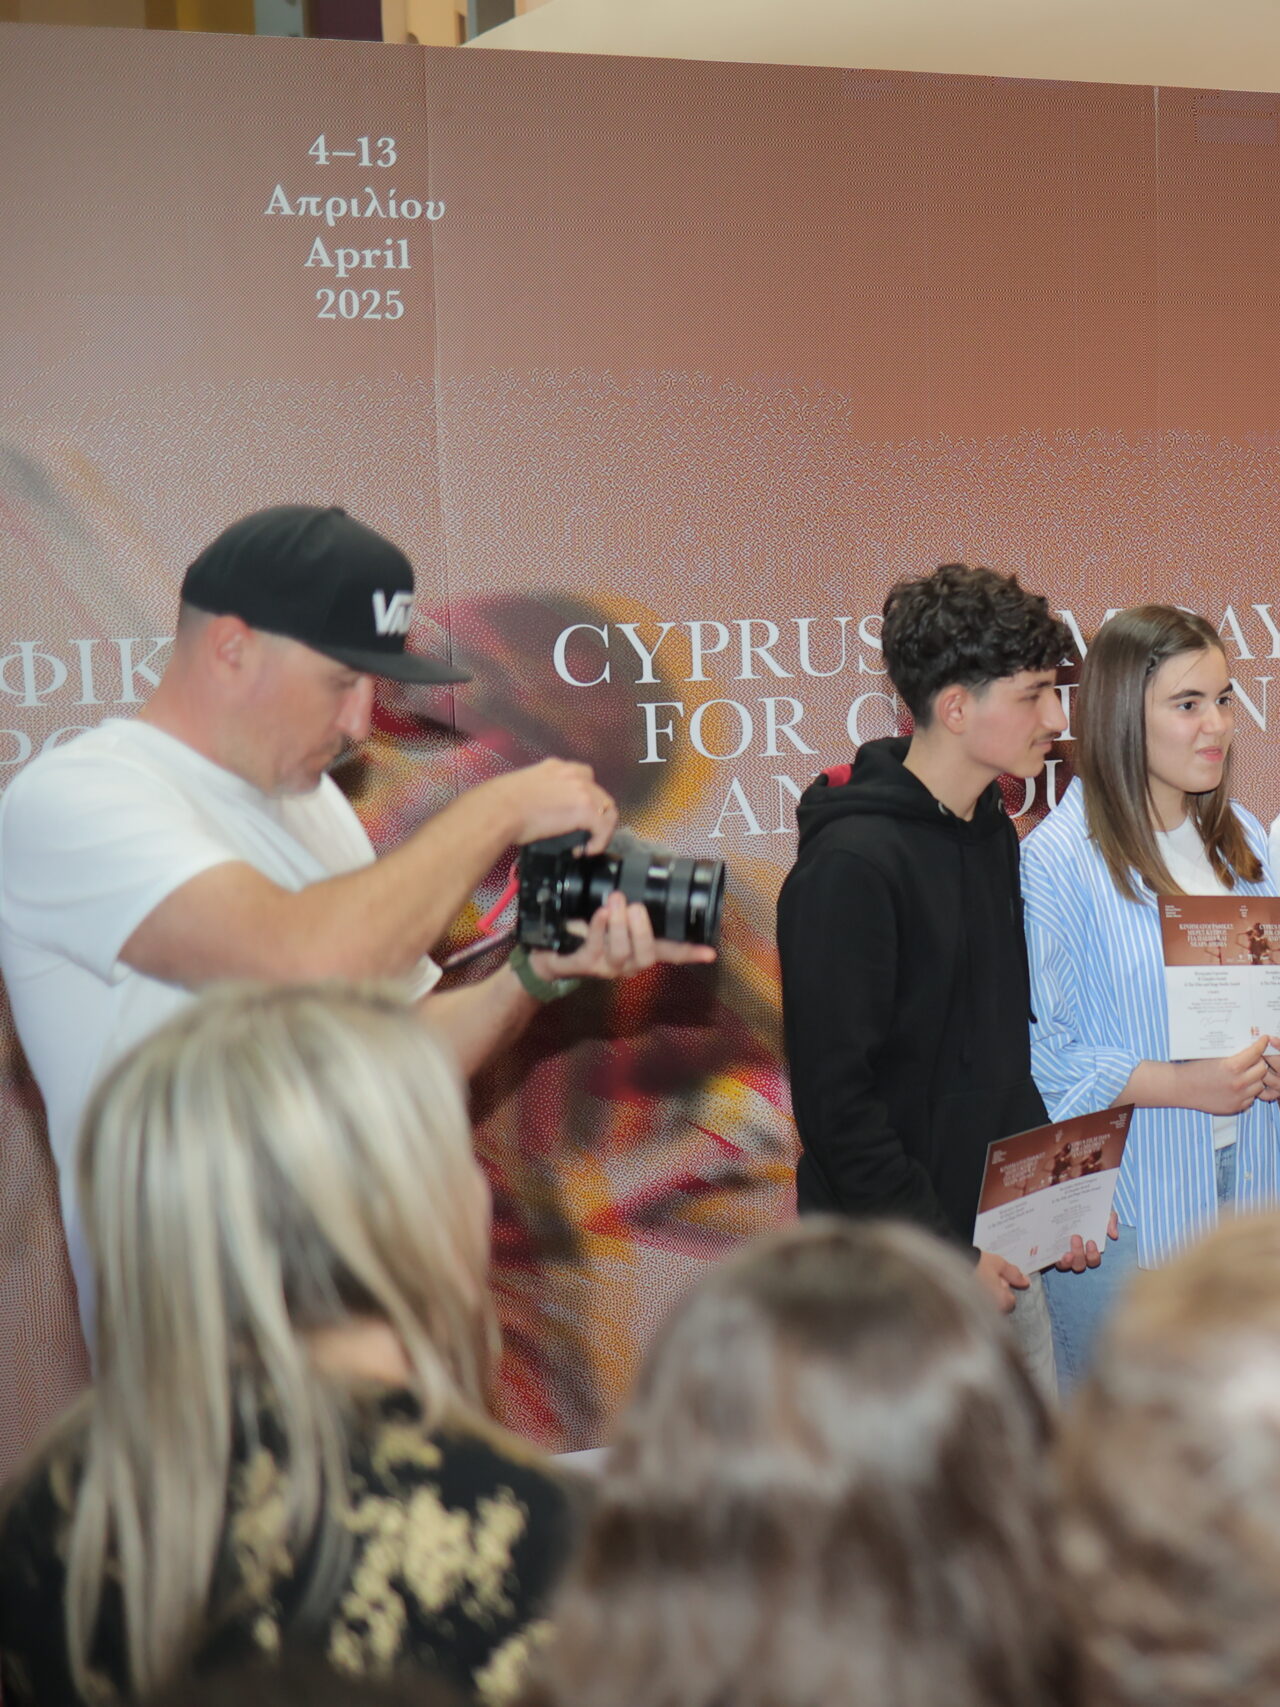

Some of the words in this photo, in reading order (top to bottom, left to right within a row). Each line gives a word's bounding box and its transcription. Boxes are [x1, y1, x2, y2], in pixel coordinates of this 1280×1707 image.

[264, 184, 446, 227] Απριλίου
[303, 236, 411, 279] April
[314, 287, 405, 321] 2025
[552, 613, 888, 688] CYPRUS
[636, 695, 820, 764] FOR
